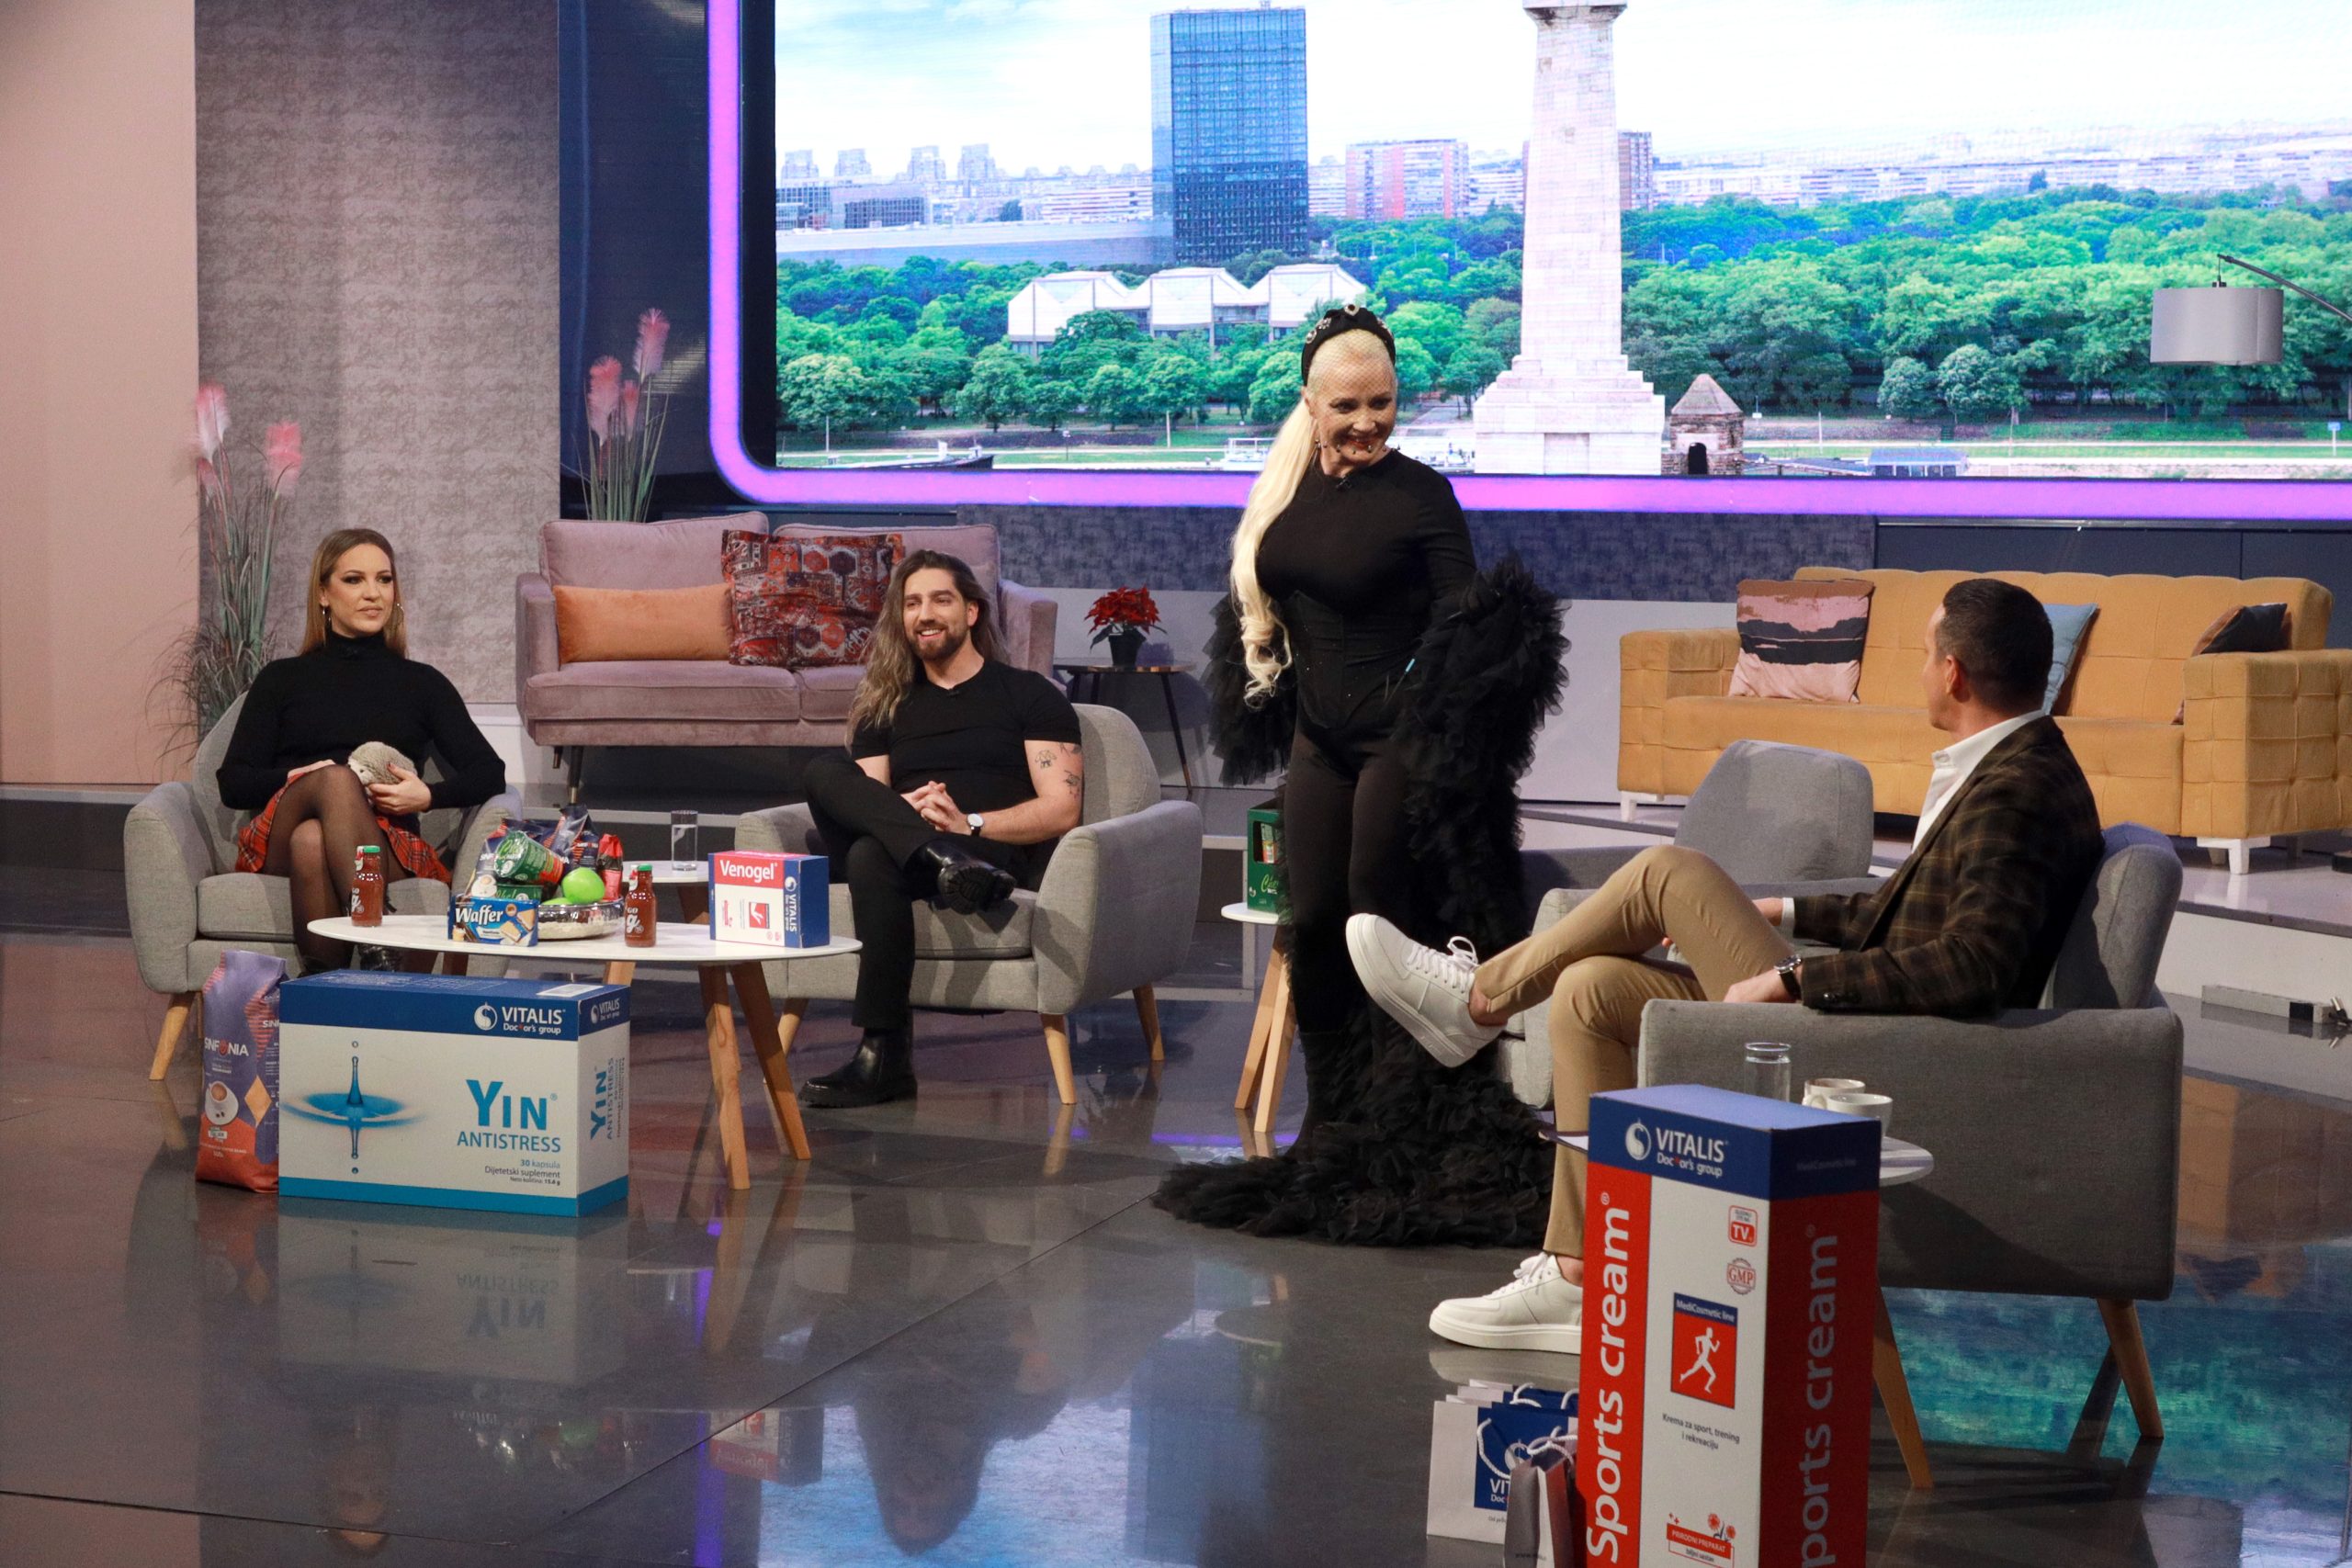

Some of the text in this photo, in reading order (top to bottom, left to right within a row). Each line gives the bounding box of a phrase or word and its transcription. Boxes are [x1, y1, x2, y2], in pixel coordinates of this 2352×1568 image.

[719, 860, 774, 883] Venogel
[456, 905, 503, 925] Waffer
[599, 998, 620, 1014] VITALIS
[502, 1007, 562, 1024] VITALIS
[538, 1026, 561, 1035] group
[458, 1131, 560, 1153] ANTISTRESS
[1656, 1127, 1724, 1163] VITALIS
[485, 1166, 560, 1179] Dijetetski suplement
[532, 1160, 560, 1169] kapsula
[1696, 1164, 1723, 1179] group
[1733, 1224, 1749, 1241] TV
[1729, 1268, 1753, 1284] GMP
[1676, 1299, 1735, 1322] MediCosmetic line
[1806, 1235, 1838, 1410] cream
[1586, 1208, 1630, 1563] Sports cream
[1662, 1414, 1684, 1427] Krema
[1685, 1421, 1692, 1429] za
[1714, 1429, 1740, 1445] trening
[1686, 1435, 1719, 1450] rekreaciju
